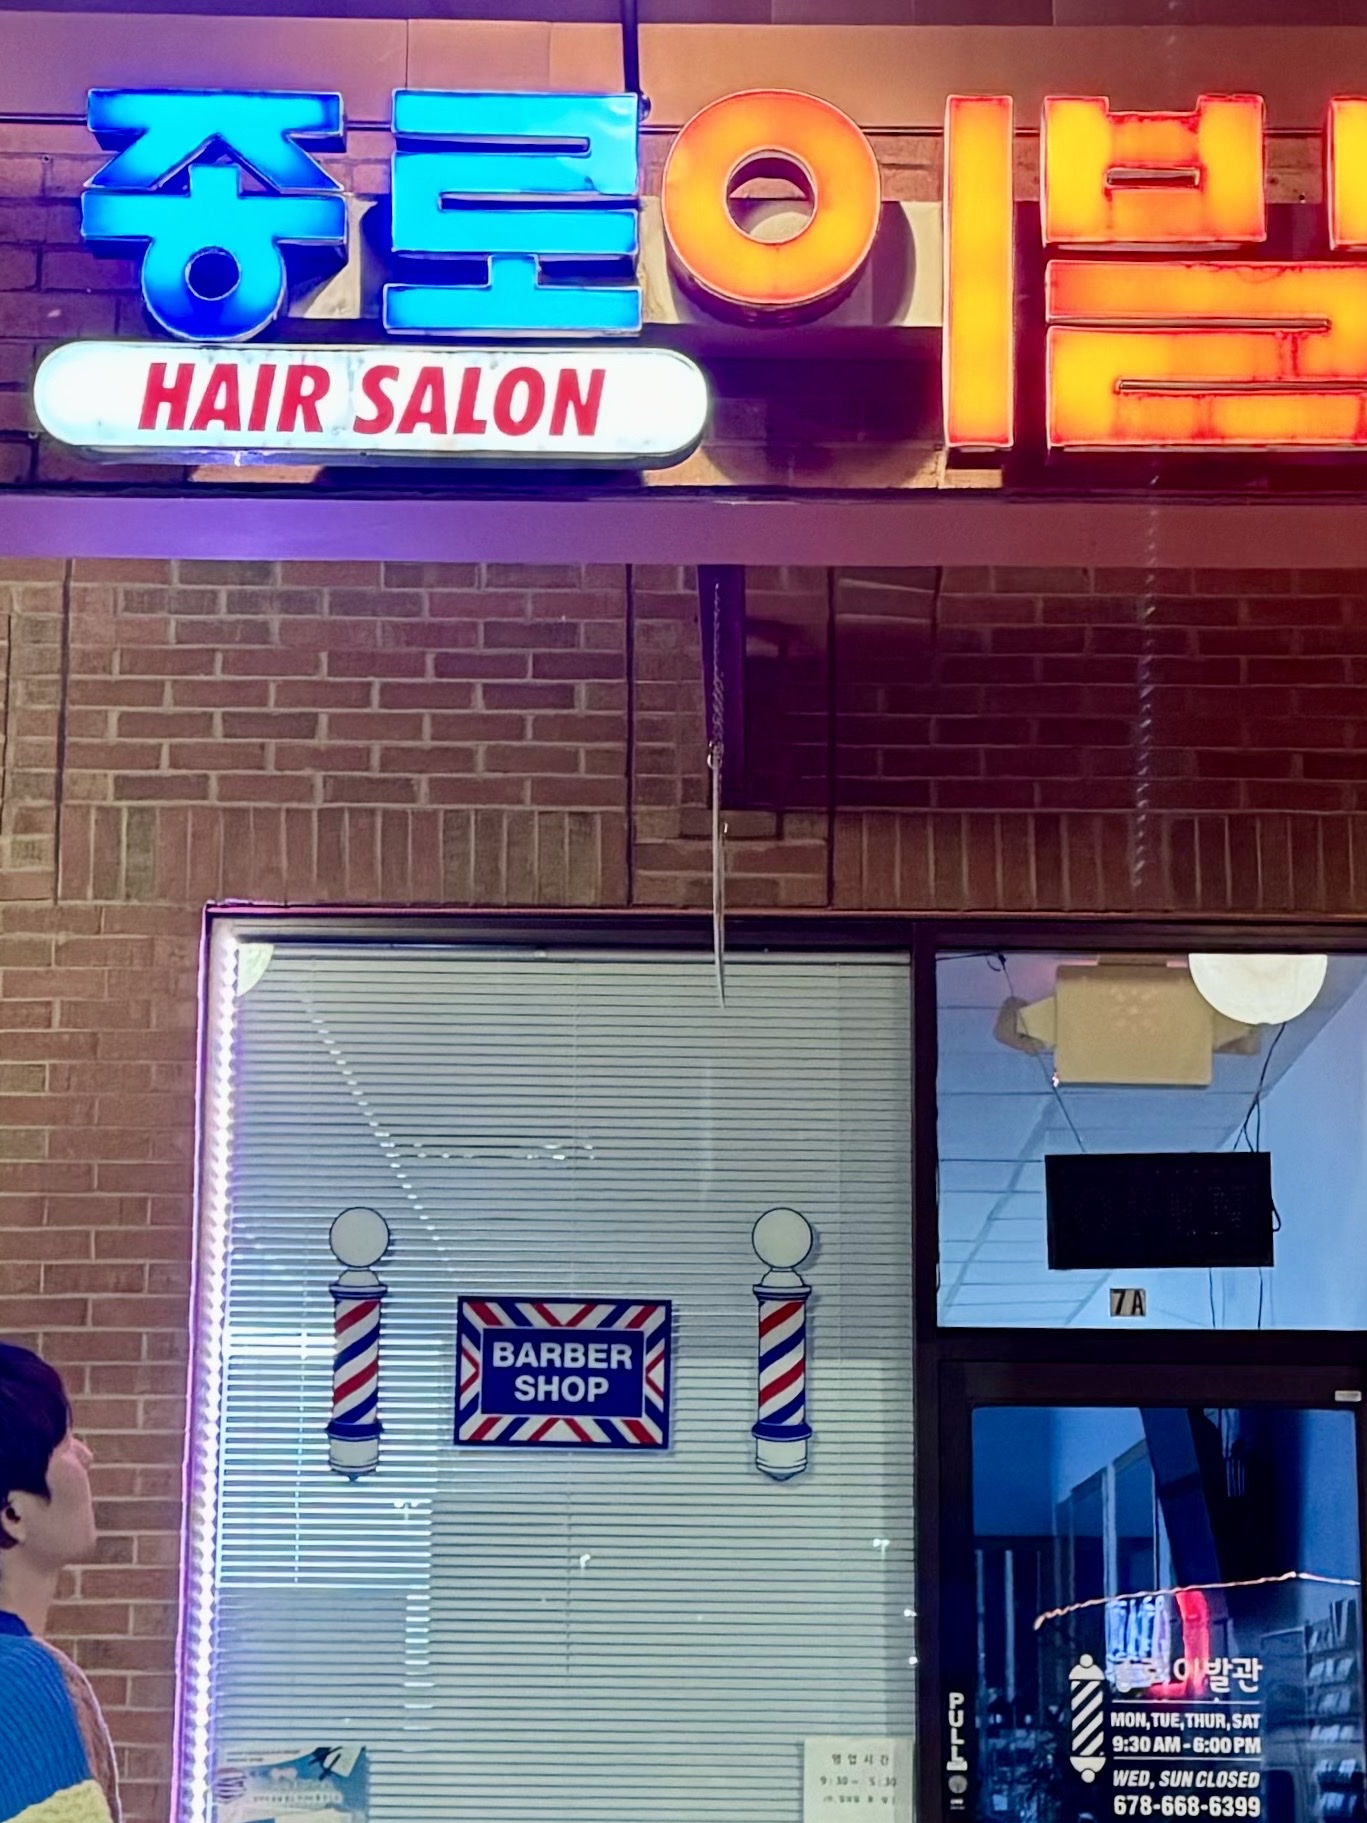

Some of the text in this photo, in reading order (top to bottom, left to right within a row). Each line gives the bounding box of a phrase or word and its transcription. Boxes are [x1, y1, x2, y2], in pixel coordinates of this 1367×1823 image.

[137, 362, 606, 437] HAIR SALON
[492, 1341, 633, 1370] BARBER
[514, 1375, 610, 1403] SHOP
[948, 1692, 965, 1764] PULL
[1112, 1736, 1151, 1753] 9:30
[1153, 1737, 1181, 1753] AM
[1193, 1737, 1232, 1753] 6:00
[1234, 1737, 1261, 1754] PM
[1113, 1769, 1260, 1789] WED, SUN CLOSED
[1113, 1795, 1261, 1817] 678-668-6399
